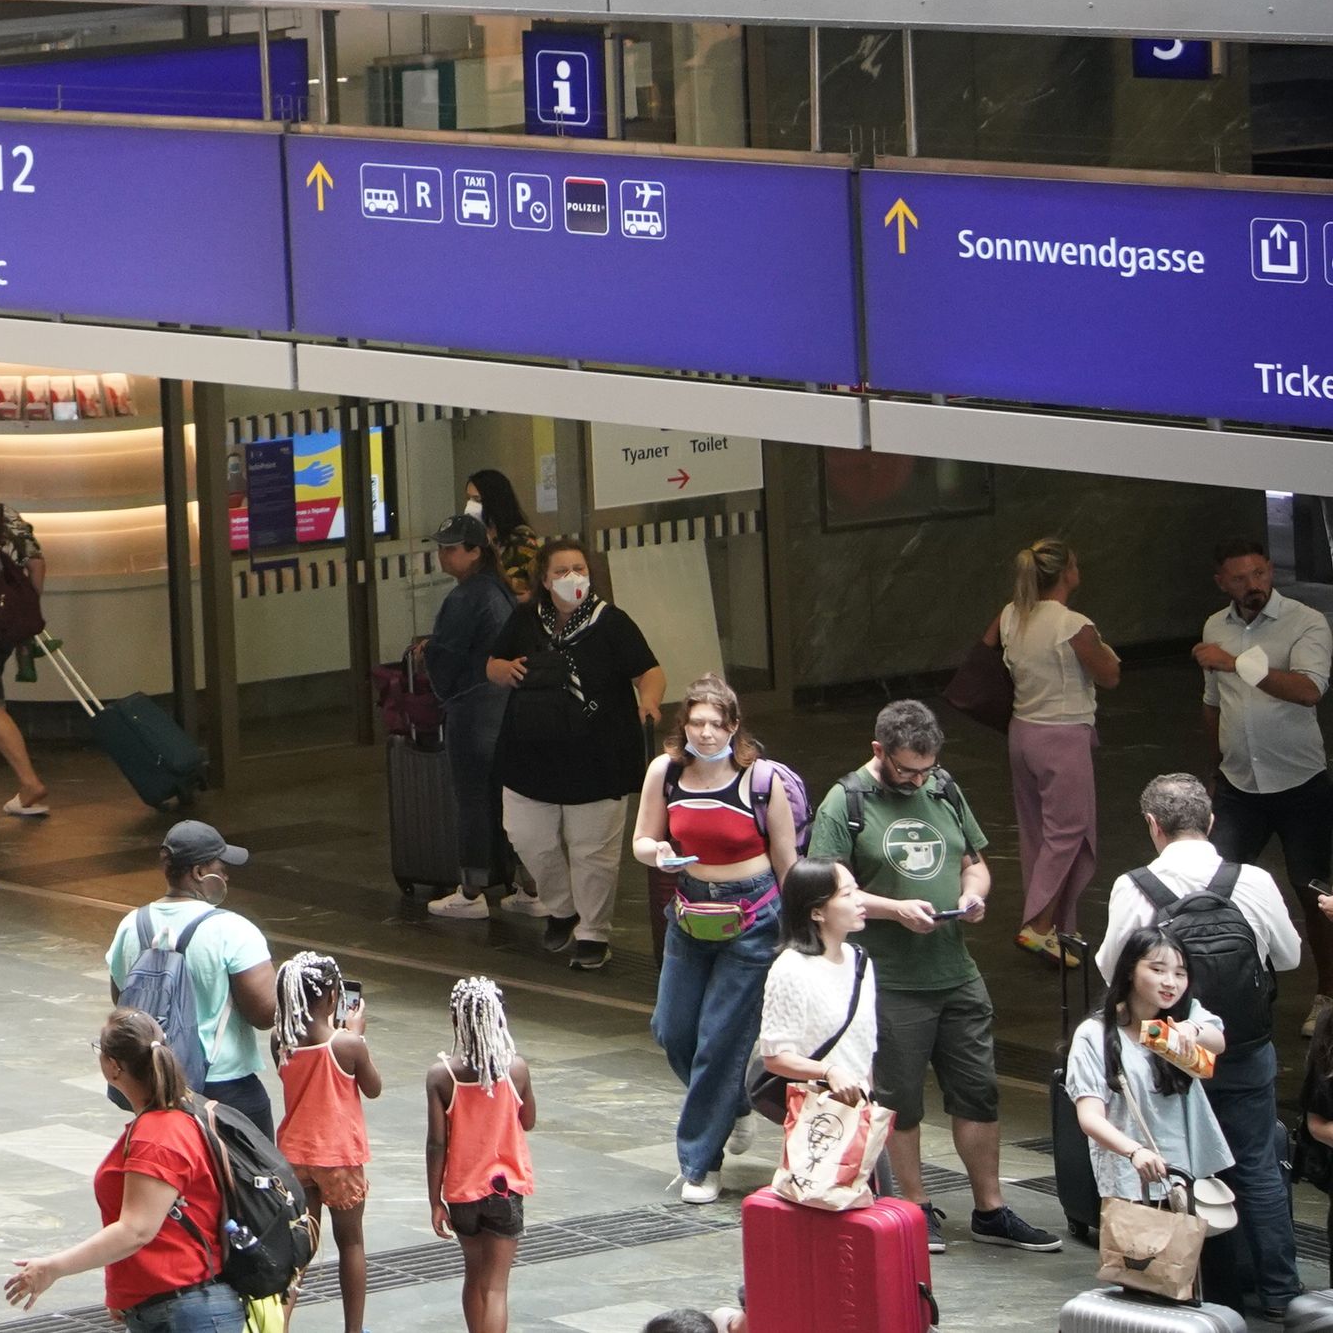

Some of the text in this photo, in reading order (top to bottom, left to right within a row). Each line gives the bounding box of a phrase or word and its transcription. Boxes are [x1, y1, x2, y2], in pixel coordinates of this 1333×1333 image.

[464, 176, 486, 188] TAXI
[567, 202, 601, 213] POLIZEI
[958, 229, 1205, 277] Sonnwendgasse
[1253, 362, 1333, 399] Ticke
[621, 445, 669, 465] Туалет
[690, 436, 729, 454] Toilet
[789, 1173, 817, 1193] KFC
